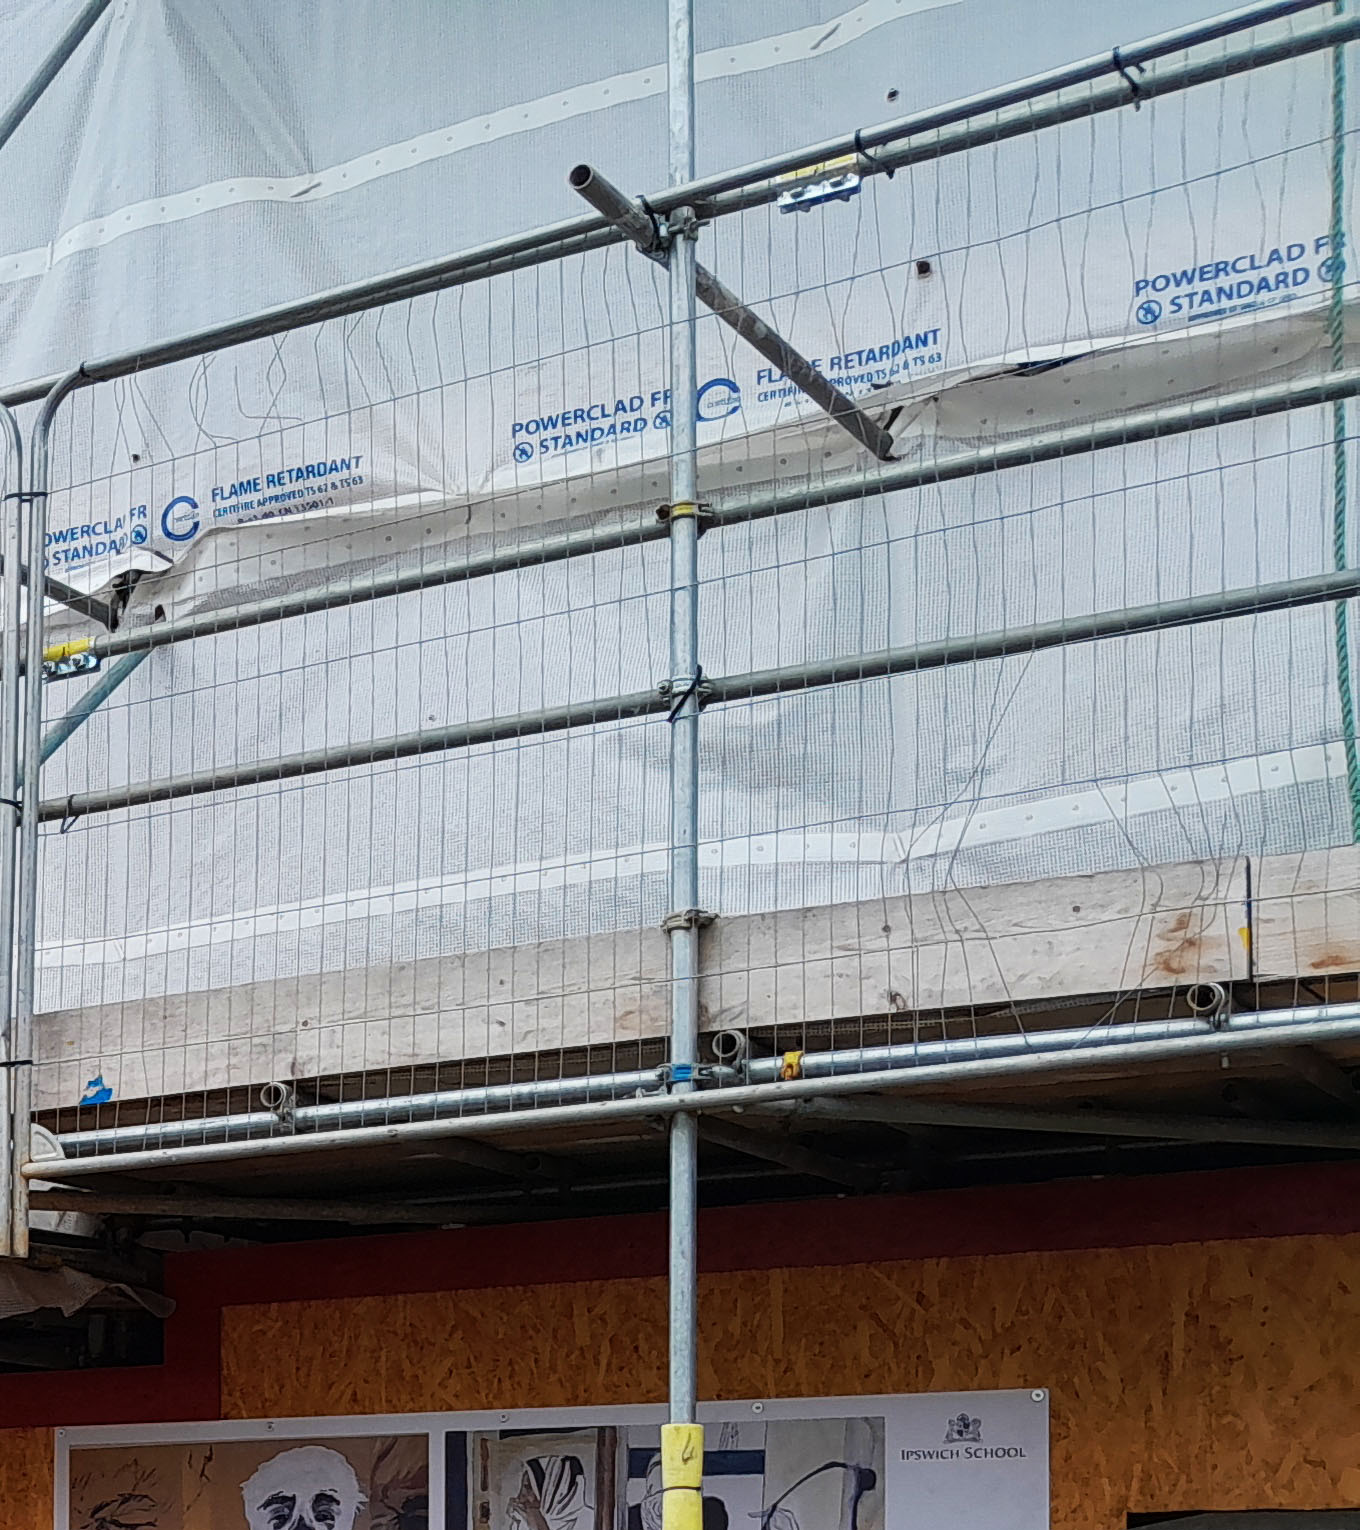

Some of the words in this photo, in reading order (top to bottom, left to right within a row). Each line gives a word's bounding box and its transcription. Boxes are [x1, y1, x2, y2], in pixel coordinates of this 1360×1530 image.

[1134, 243, 1306, 298] POWERCLAD
[1168, 266, 1310, 314] STANDARD
[829, 328, 942, 372] RETARDANT
[830, 371, 873, 387] PROVED
[511, 395, 645, 439] POWERCLAD
[539, 417, 648, 455] STANDARD
[211, 477, 262, 502] FLAME
[266, 455, 364, 489] RETARDANT
[256, 489, 304, 509] APPROVED
[44, 514, 127, 548] OWERCLA
[129, 505, 148, 523] FR
[900, 1449, 960, 1461] IPSWICH
[964, 1447, 1028, 1460] SCHOOL
